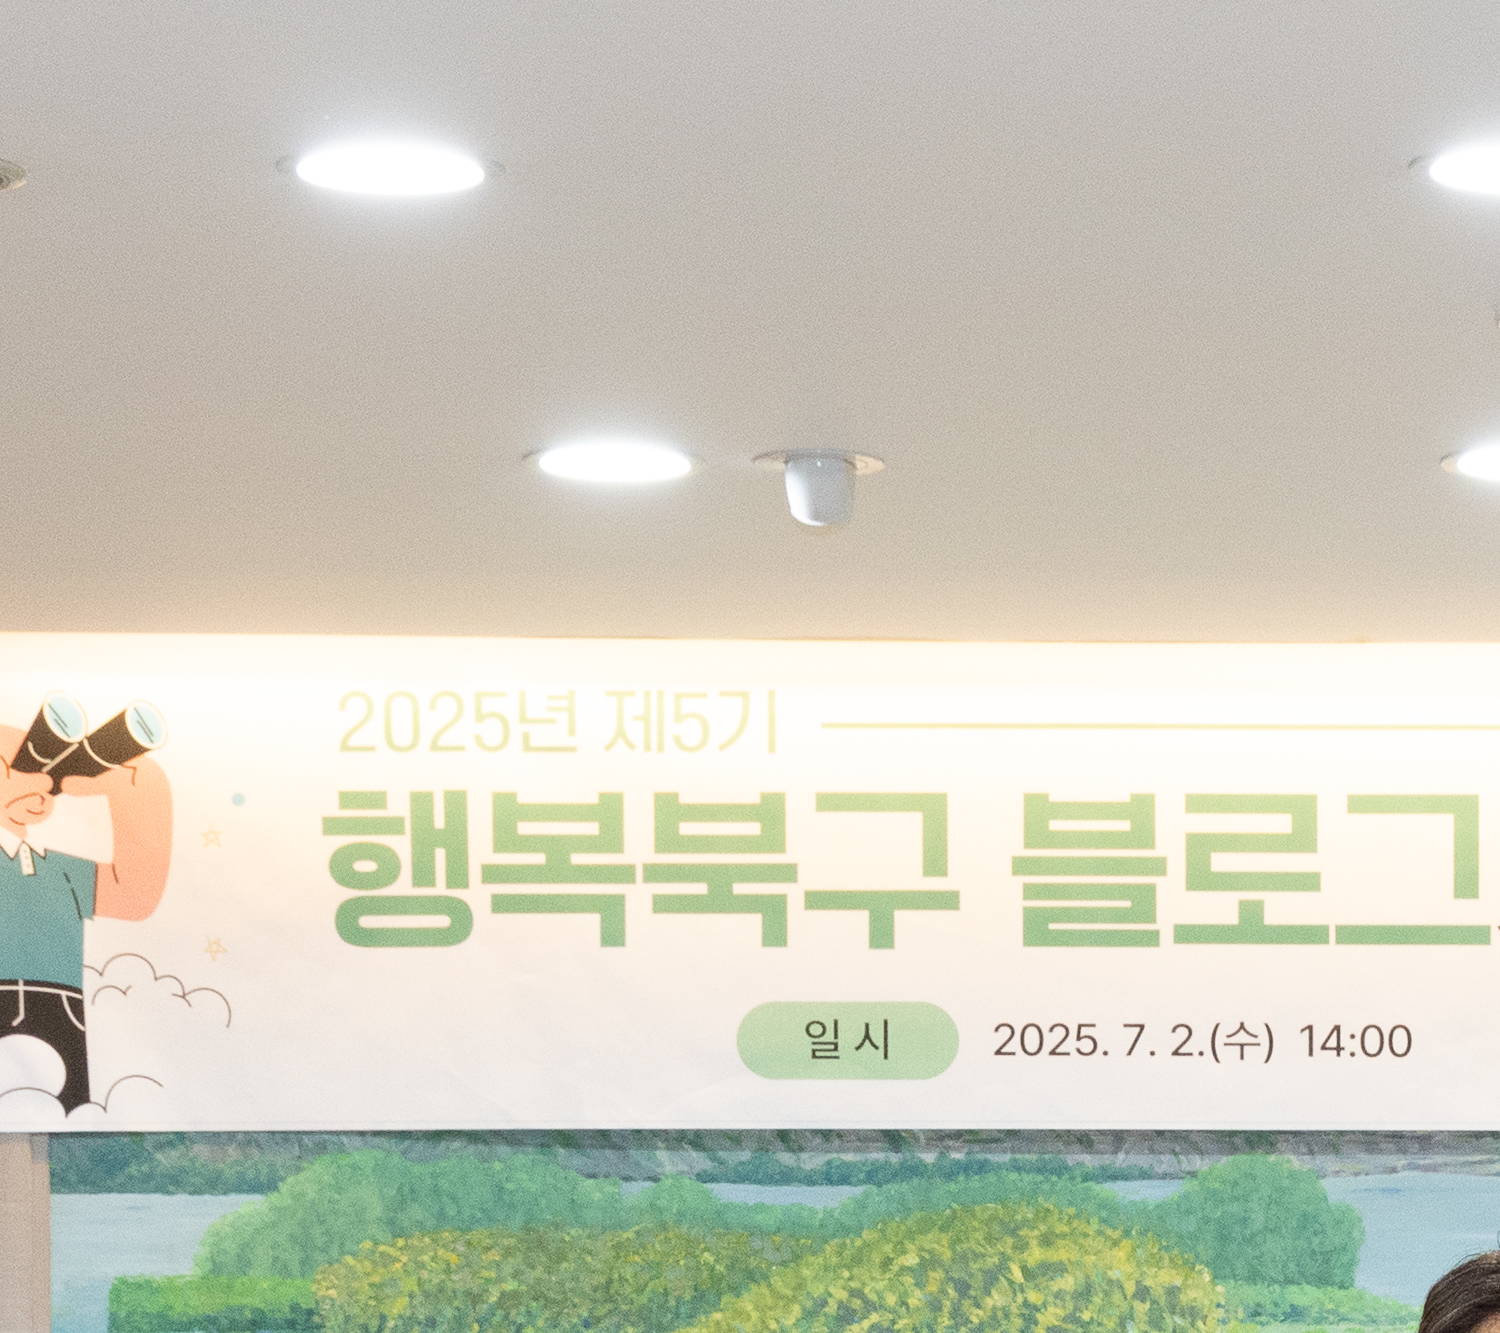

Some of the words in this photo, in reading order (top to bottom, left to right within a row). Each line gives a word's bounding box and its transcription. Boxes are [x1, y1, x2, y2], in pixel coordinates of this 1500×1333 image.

[337, 688, 581, 757] 2025년
[601, 688, 781, 757] 제5기
[320, 788, 961, 950] 행복북구
[1299, 1023, 1413, 1058] 14:00
